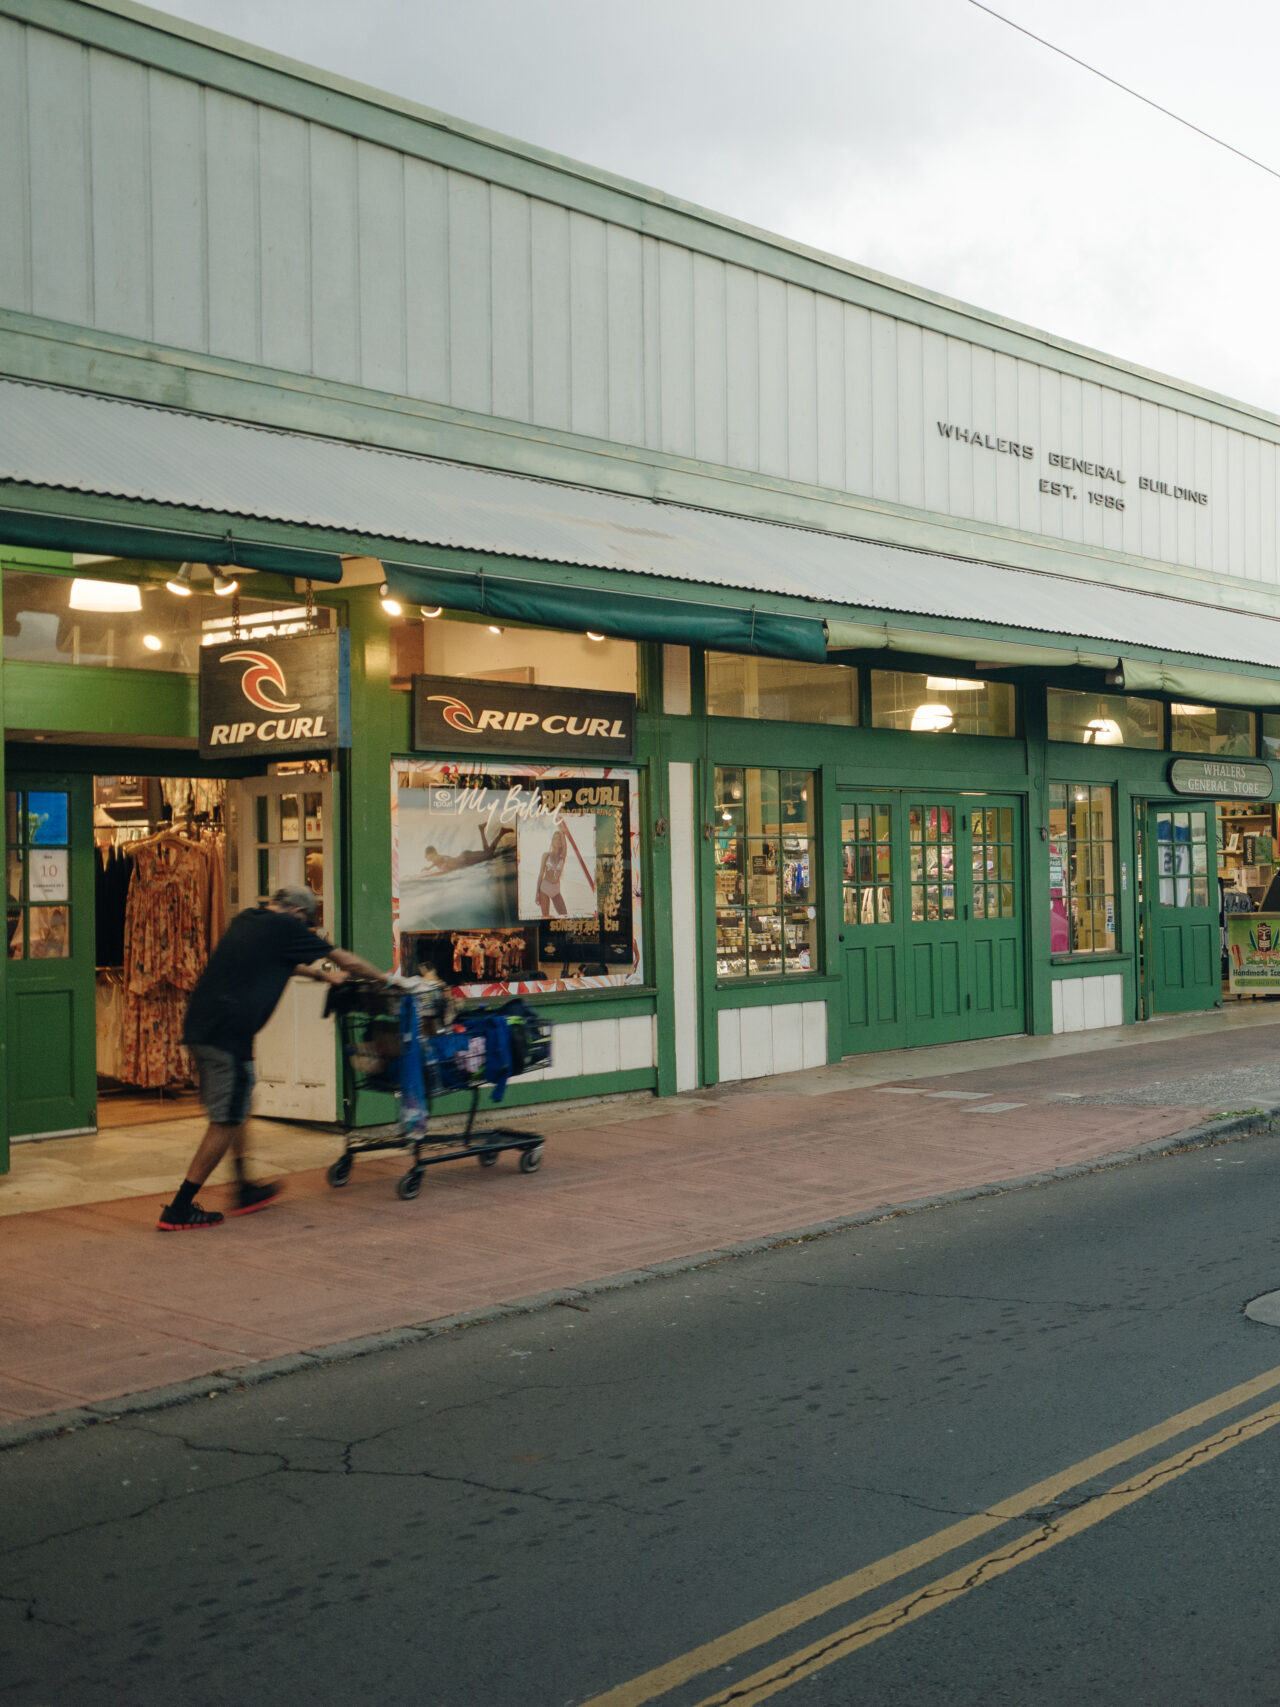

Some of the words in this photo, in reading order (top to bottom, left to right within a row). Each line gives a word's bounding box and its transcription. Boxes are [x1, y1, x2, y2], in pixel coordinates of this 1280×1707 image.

[937, 420, 1034, 460] WHALERS
[1048, 452, 1127, 485] GENERAL
[1138, 476, 1209, 506] BUILDING
[1039, 478, 1078, 500] EST.
[1088, 491, 1126, 512] 1986
[209, 722, 256, 746] RIP
[257, 716, 328, 741] CURL
[477, 710, 540, 732] RIP
[541, 715, 627, 739] CURL
[1203, 763, 1246, 778] WHALERS
[541, 789, 573, 808] RIP
[575, 786, 624, 807] CURL
[1188, 779, 1230, 793] GENERAL
[1233, 782, 1259, 794] STORE
[455, 786, 498, 830] My
[41, 864, 58, 878] 10
[1233, 969, 1268, 977] Handmade
[1270, 969, 1280, 977] Ice
